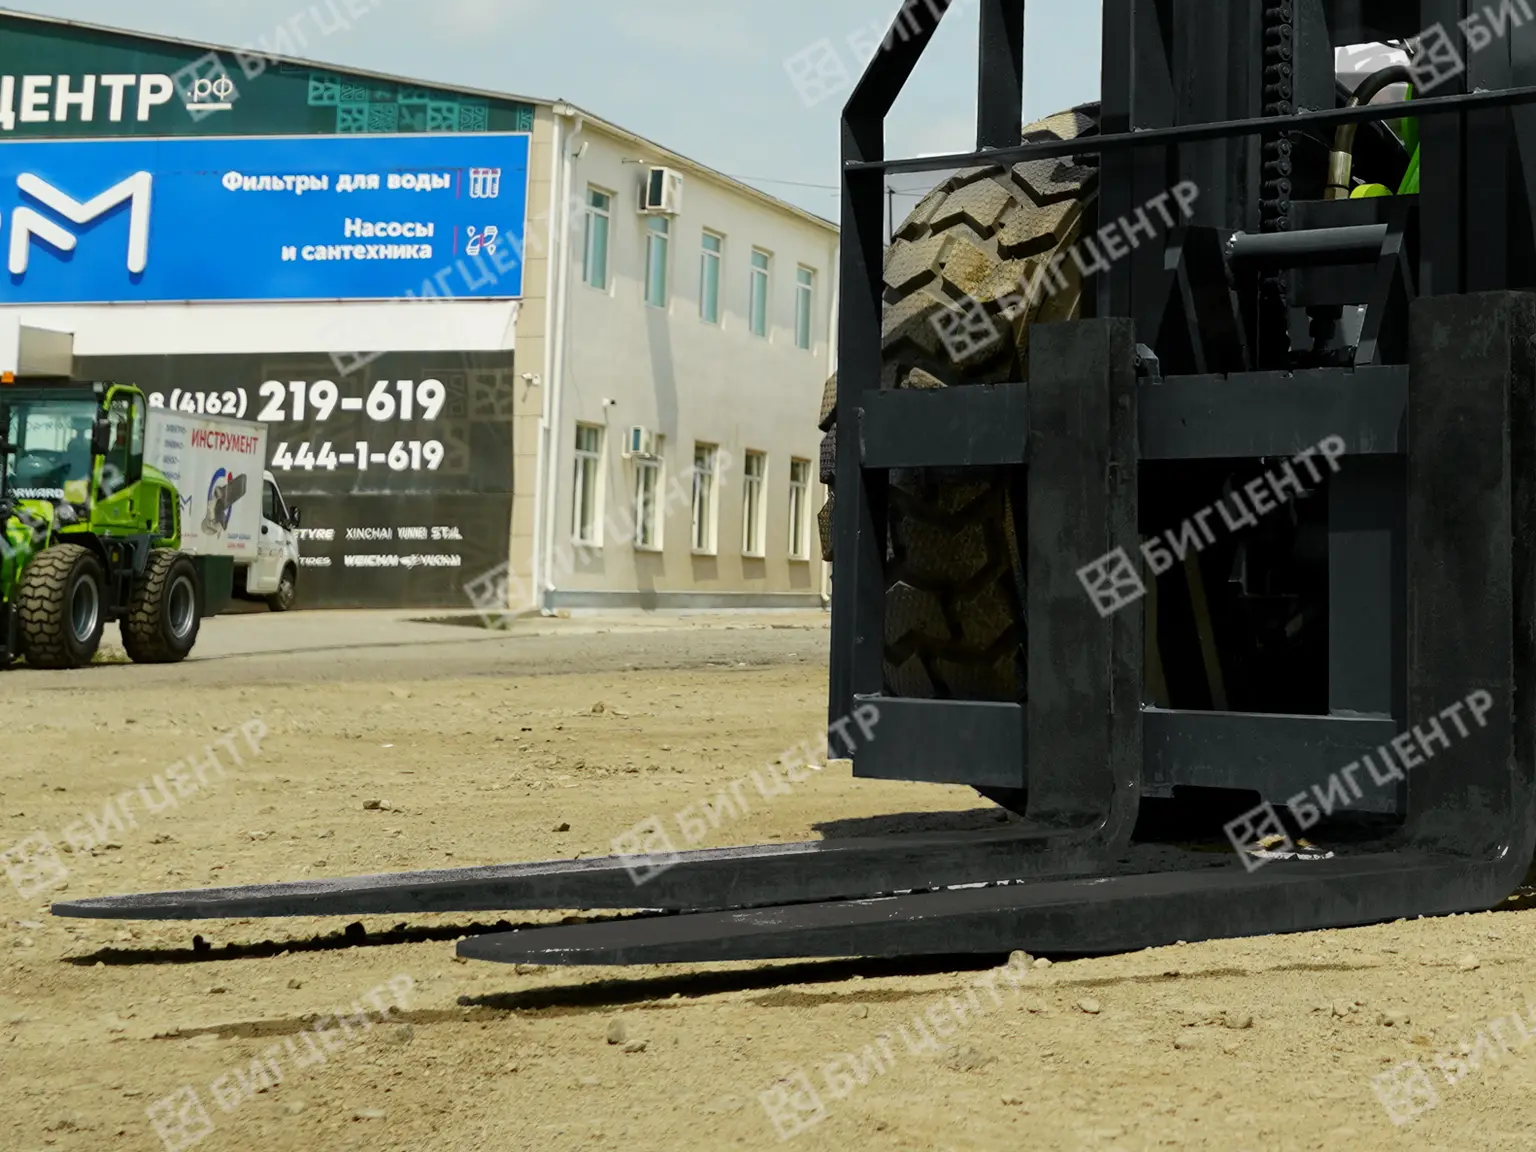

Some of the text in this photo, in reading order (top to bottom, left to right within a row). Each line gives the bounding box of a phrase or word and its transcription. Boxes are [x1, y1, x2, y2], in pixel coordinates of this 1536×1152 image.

[222, 171, 450, 195] Фильтры для воды
[344, 217, 434, 238] Насосы
[281, 243, 433, 261] и сантехника
[170, 388, 248, 418] (4162)
[256, 378, 447, 422] 219-619
[191, 428, 259, 455] ИНСТРУМЕНТ
[271, 439, 445, 471] 444-1-619
[345, 526, 393, 541] XINCHAI
